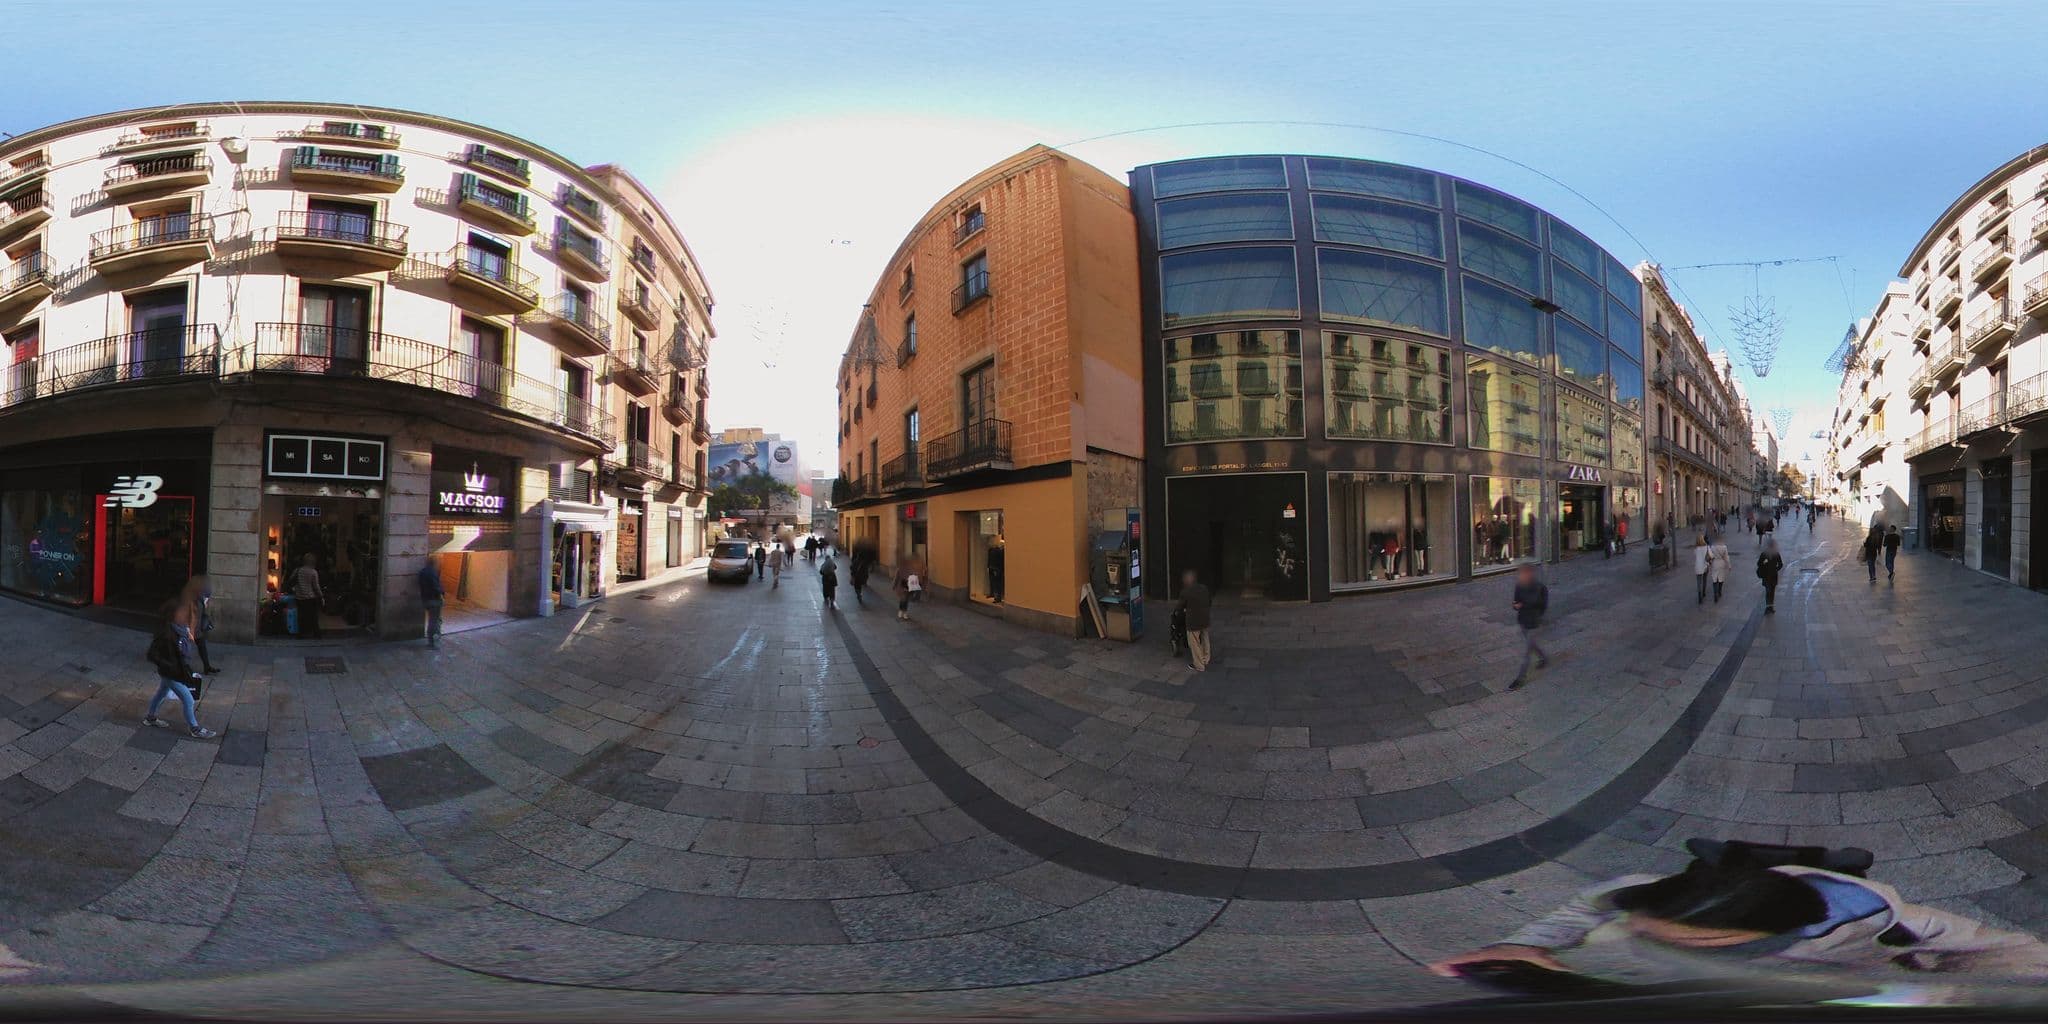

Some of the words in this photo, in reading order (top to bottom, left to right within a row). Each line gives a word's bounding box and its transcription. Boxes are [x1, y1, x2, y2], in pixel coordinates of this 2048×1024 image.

[285, 451, 295, 459] MI
[1569, 464, 1601, 481] ZARA
[63, 553, 75, 561] ON
